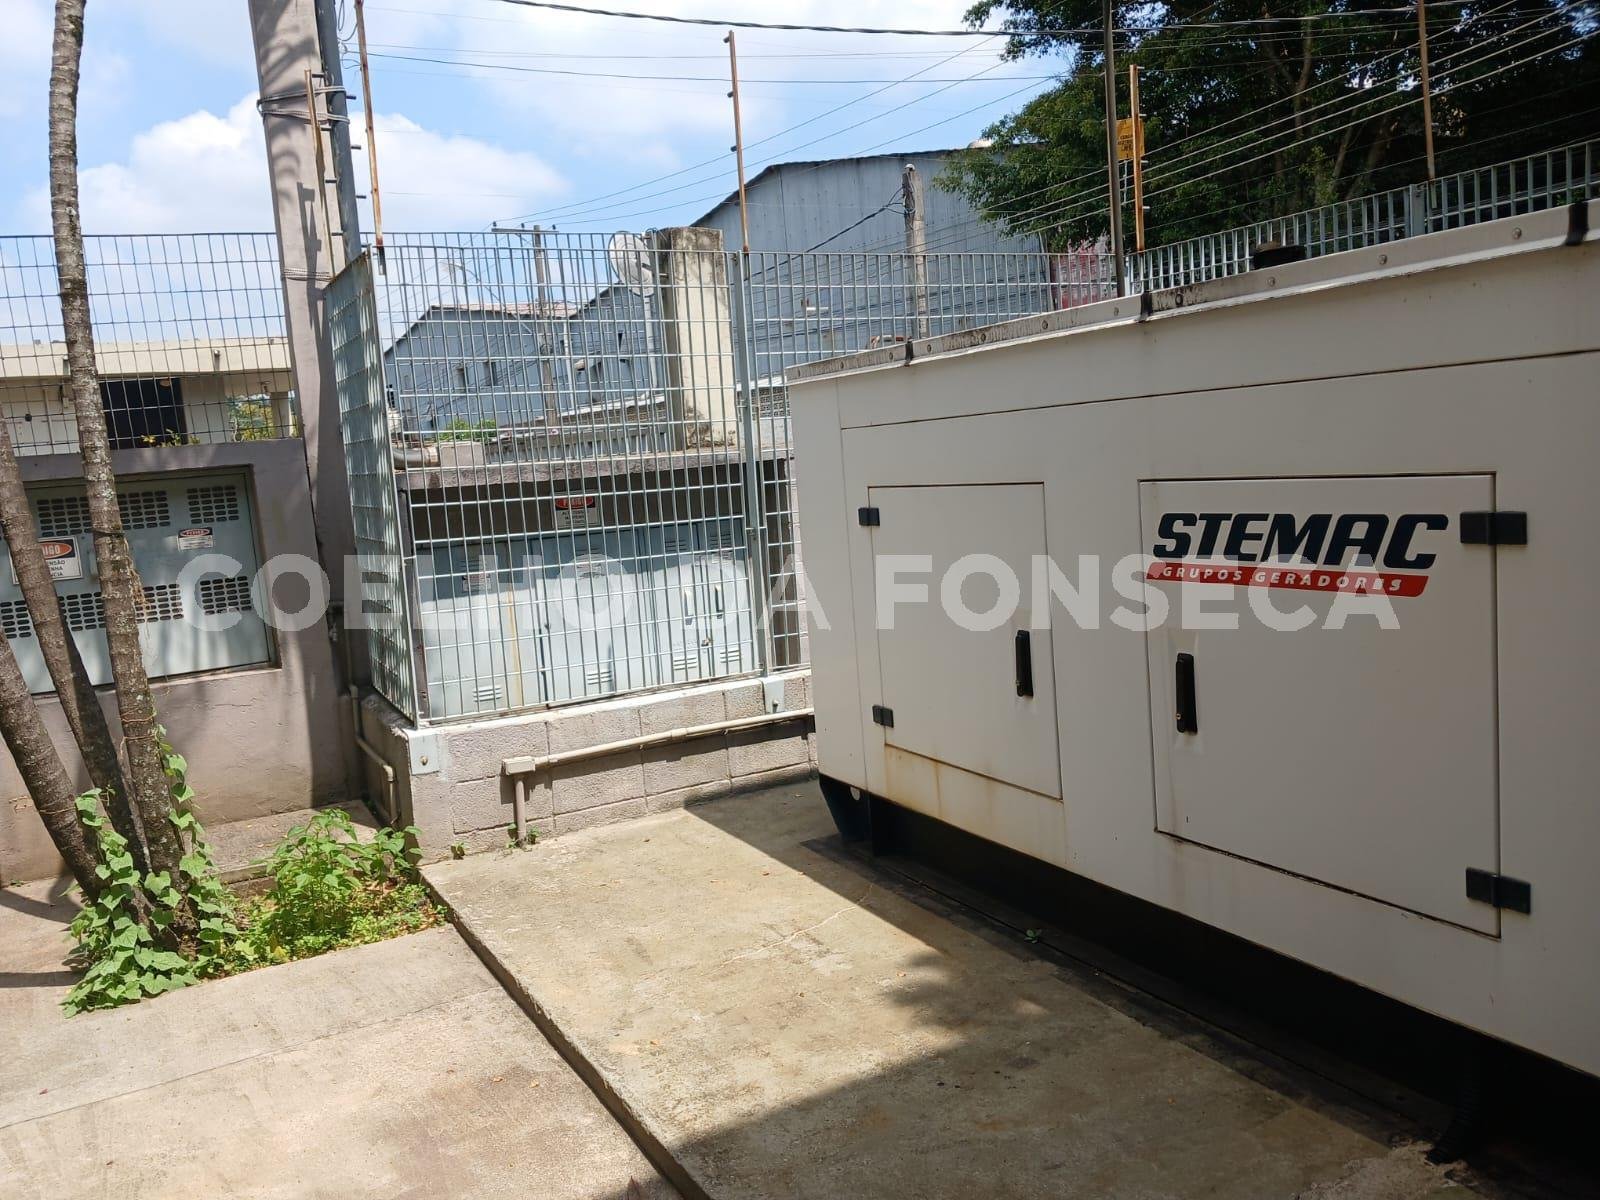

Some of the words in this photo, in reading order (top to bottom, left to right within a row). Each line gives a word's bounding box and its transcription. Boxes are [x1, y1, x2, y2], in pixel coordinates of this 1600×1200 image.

[1153, 513, 1448, 569] STEMAC
[1162, 566, 1243, 581] GRUPOS
[1254, 571, 1402, 592] GERADORES
